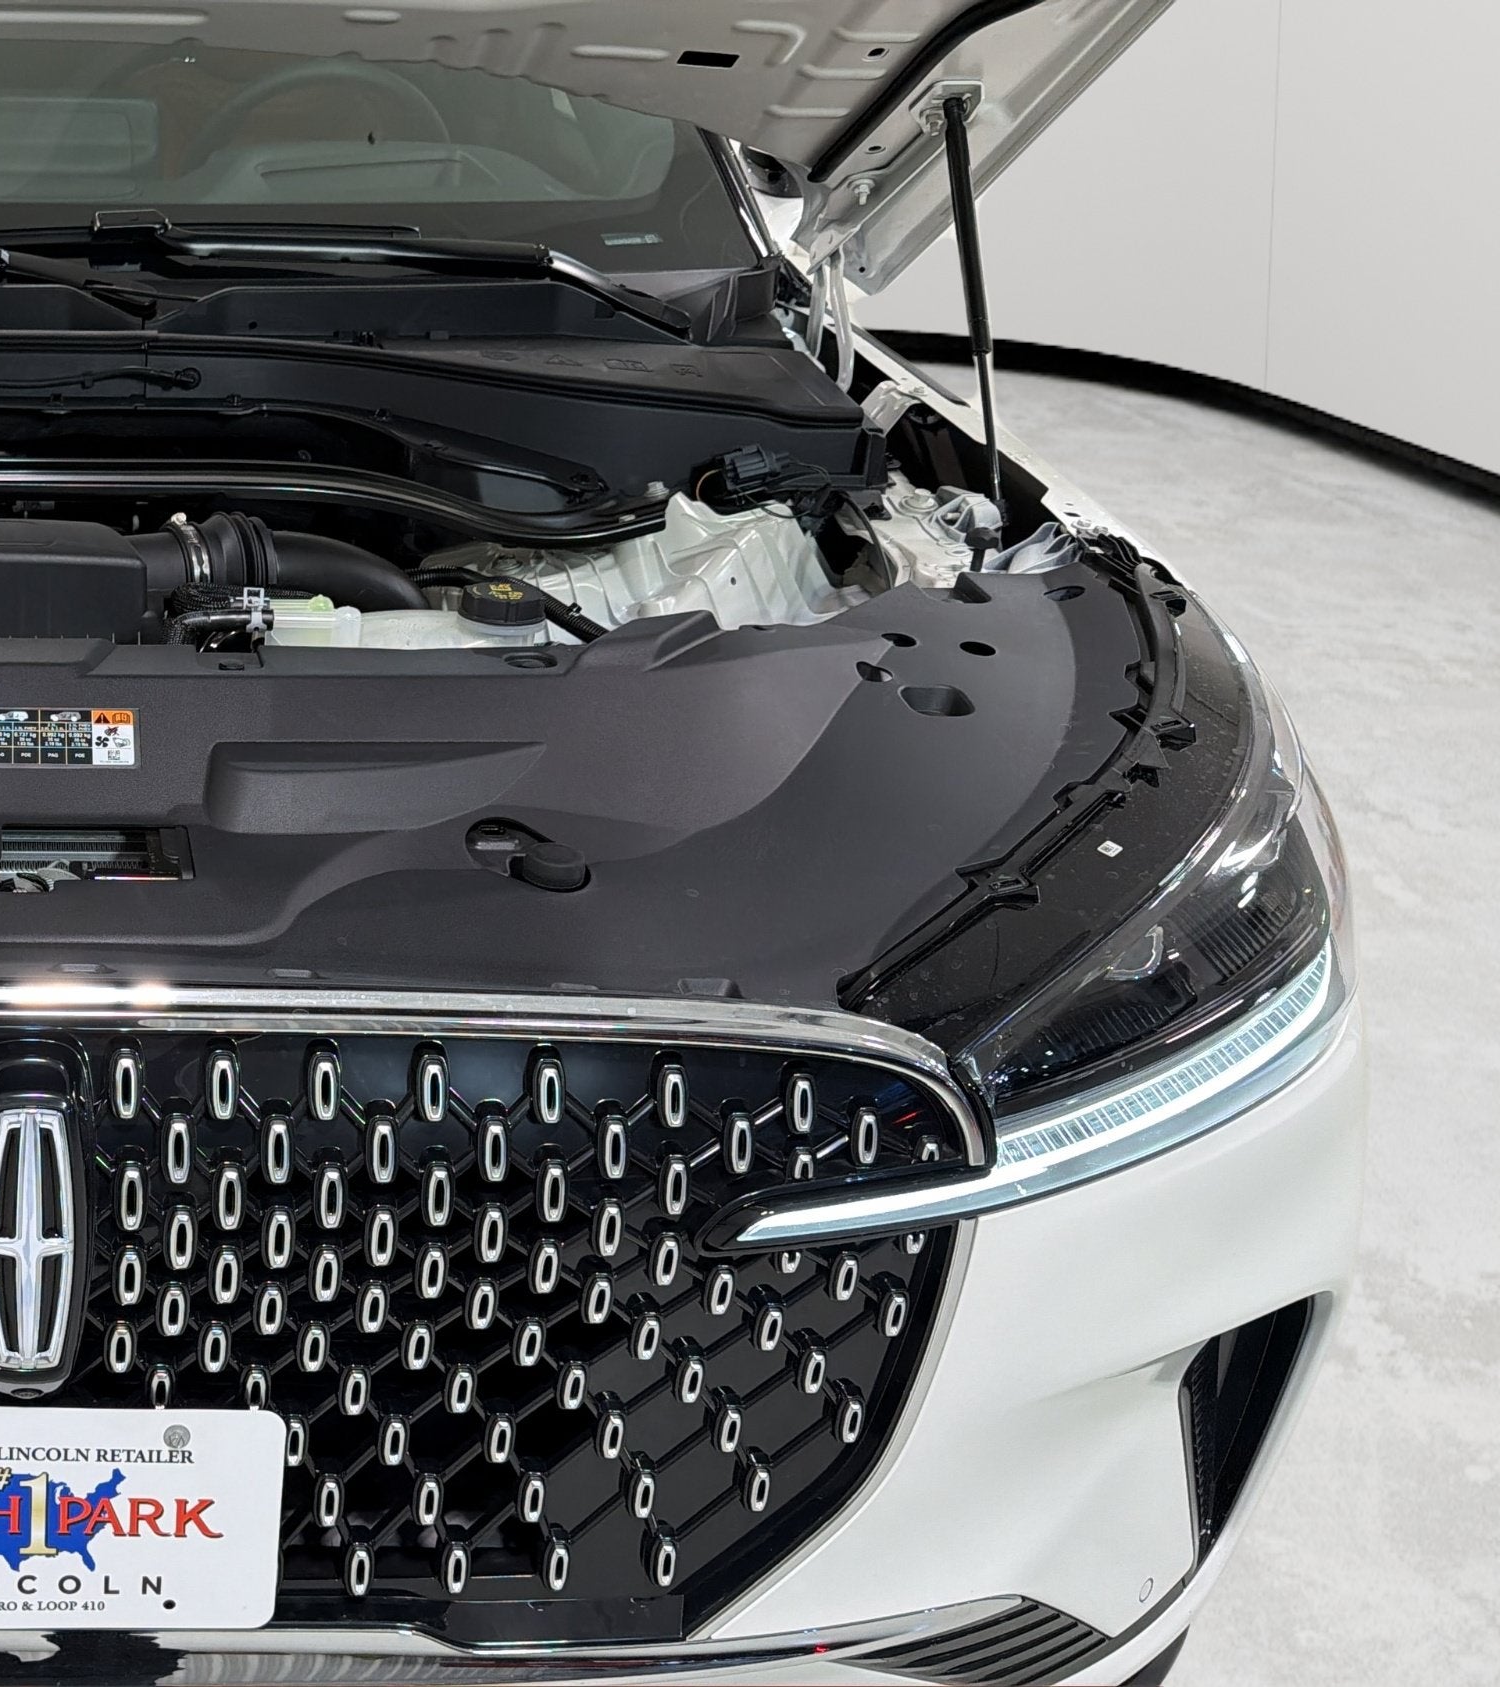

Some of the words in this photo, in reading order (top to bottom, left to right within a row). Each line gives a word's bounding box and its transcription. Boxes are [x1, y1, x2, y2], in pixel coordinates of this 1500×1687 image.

[95, 1448, 195, 1464] RETAILER
[56, 1496, 224, 1538] PARK
[21, 1600, 34, 1612] &
[37, 1600, 78, 1611] LOOP
[81, 1600, 106, 1612] 410
